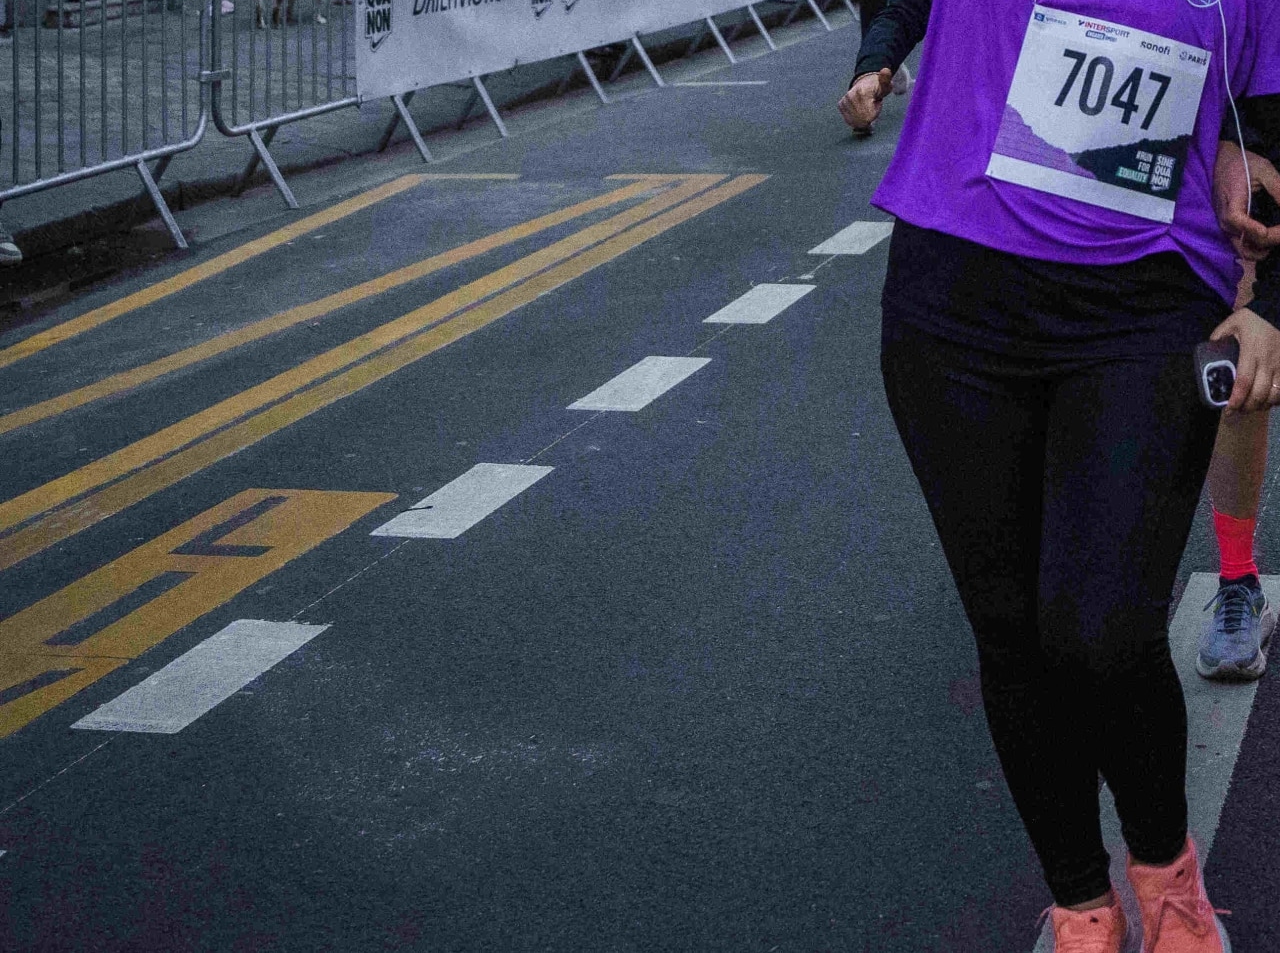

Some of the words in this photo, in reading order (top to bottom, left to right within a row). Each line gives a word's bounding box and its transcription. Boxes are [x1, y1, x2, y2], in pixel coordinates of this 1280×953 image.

[367, 8, 391, 34] NON
[1084, 22, 1130, 39] INTERSPORT
[1188, 54, 1207, 66] PARIS
[1054, 48, 1172, 130] 7047
[1154, 165, 1171, 178] QUA
[1156, 155, 1174, 169] SINE
[1151, 174, 1170, 187] NON
